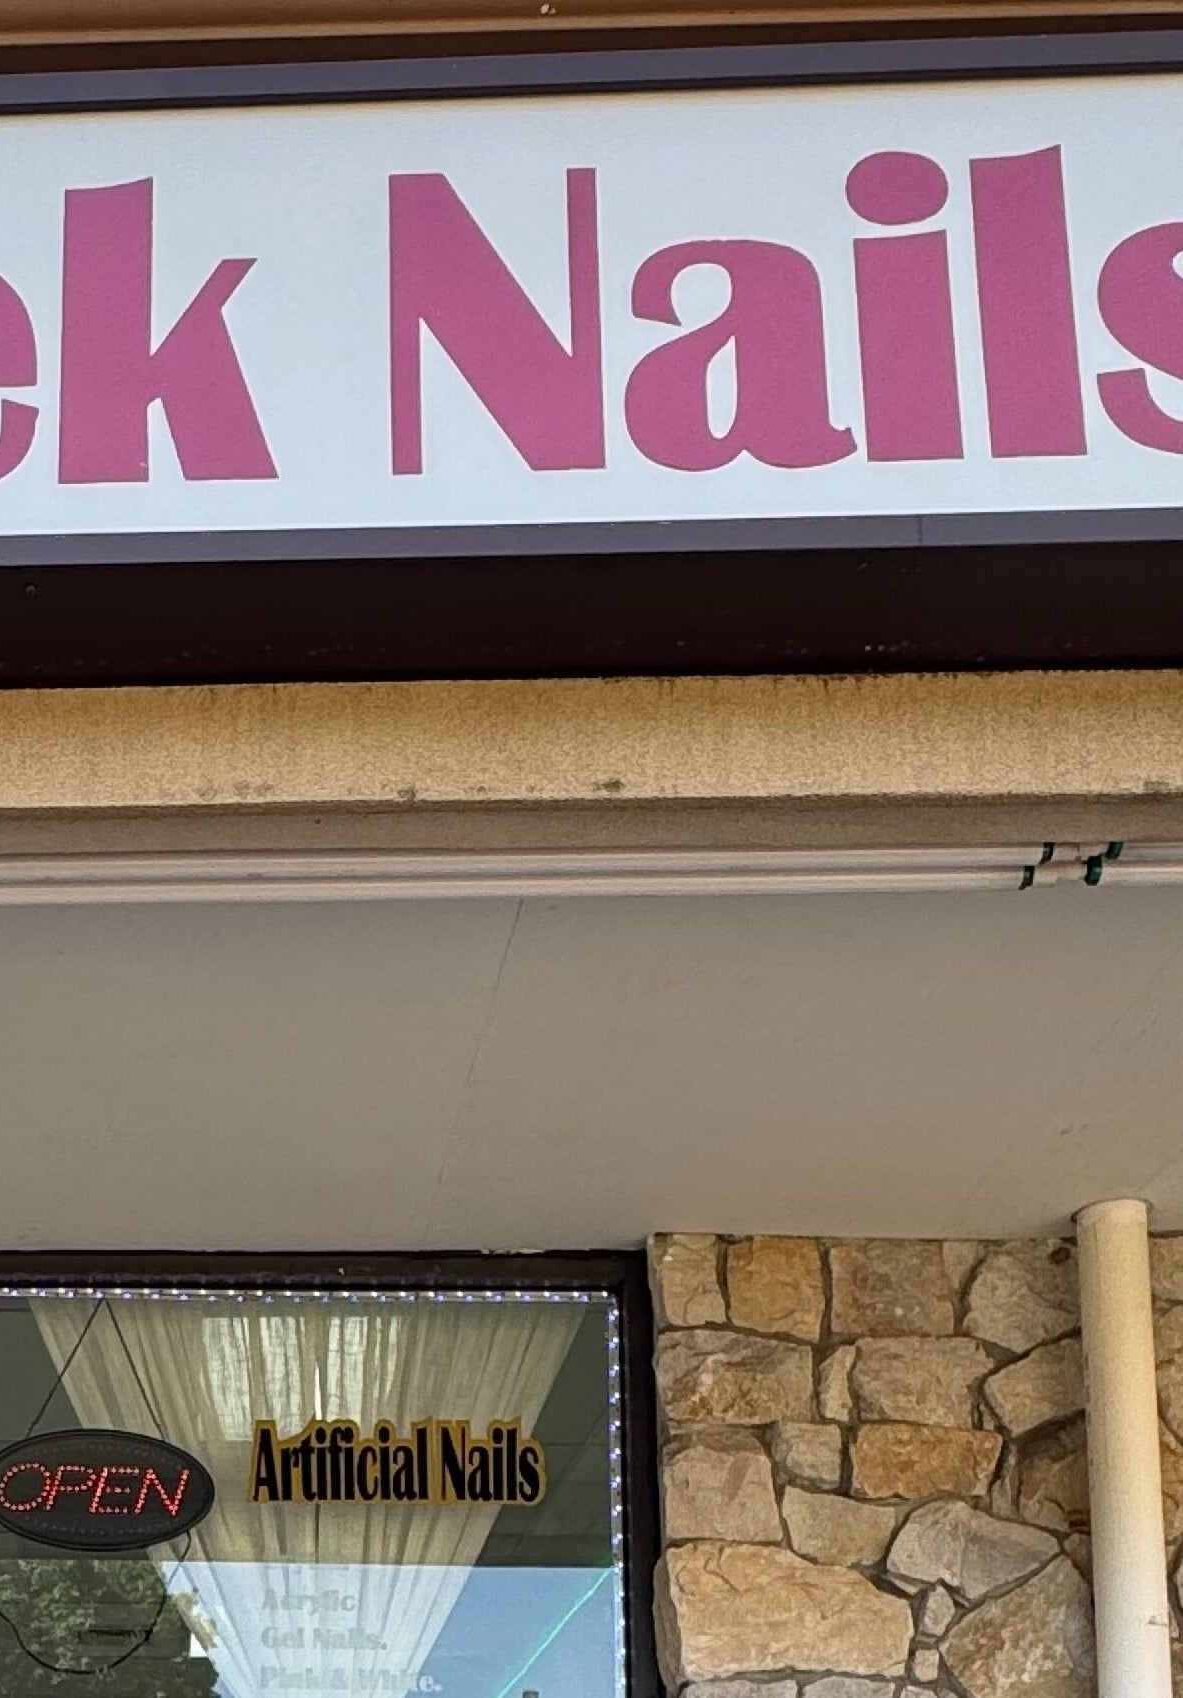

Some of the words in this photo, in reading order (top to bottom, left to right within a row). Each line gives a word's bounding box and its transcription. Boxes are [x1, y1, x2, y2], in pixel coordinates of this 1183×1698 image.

[389, 143, 1183, 475] Nails
[252, 1426, 430, 1502] Artificial
[440, 1426, 541, 1503] Nails
